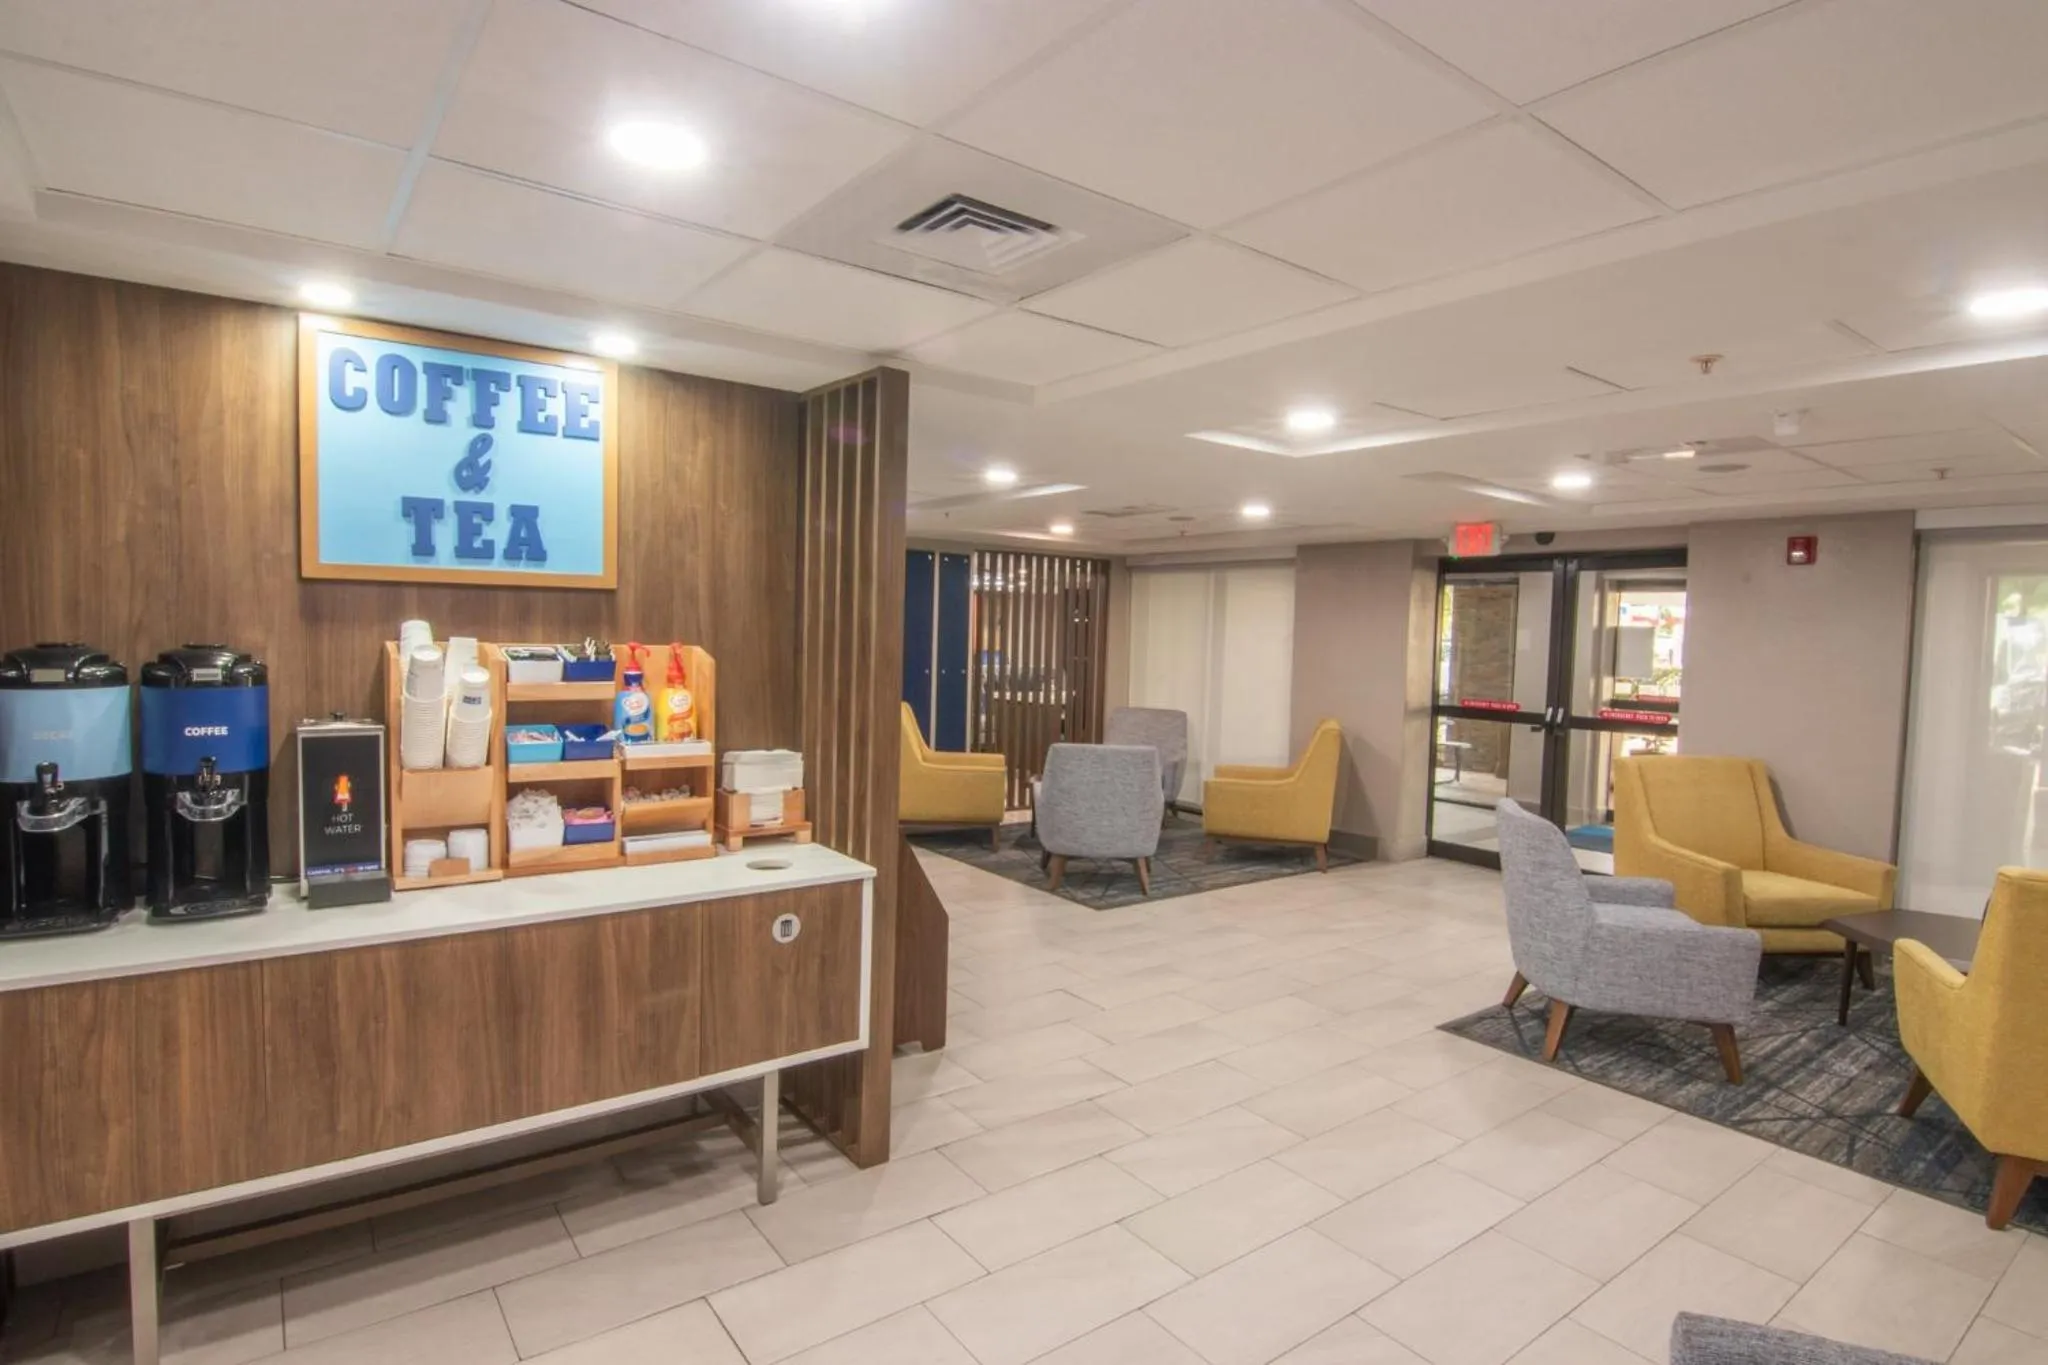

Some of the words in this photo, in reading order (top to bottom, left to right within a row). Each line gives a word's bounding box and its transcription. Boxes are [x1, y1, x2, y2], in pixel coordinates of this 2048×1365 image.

[328, 347, 600, 441] COFFEE
[453, 432, 494, 494] &
[401, 496, 547, 562] TEA
[184, 726, 229, 737] COFFEE
[323, 823, 362, 836] WATER
[331, 812, 354, 824] HOT
